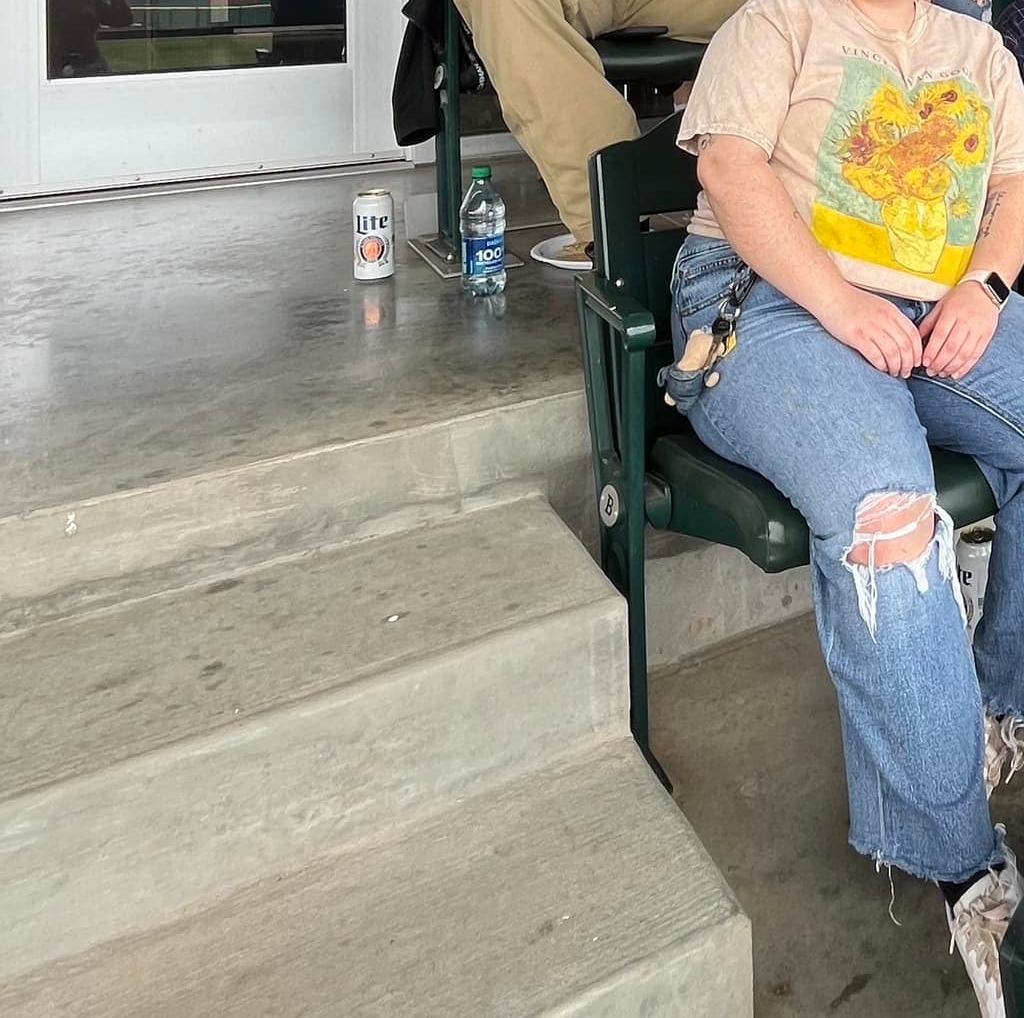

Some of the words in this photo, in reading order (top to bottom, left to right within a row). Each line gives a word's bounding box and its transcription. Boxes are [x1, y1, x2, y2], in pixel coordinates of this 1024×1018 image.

[939, 66, 974, 83] GO
[356, 214, 389, 236] Lite
[957, 563, 974, 588] te
